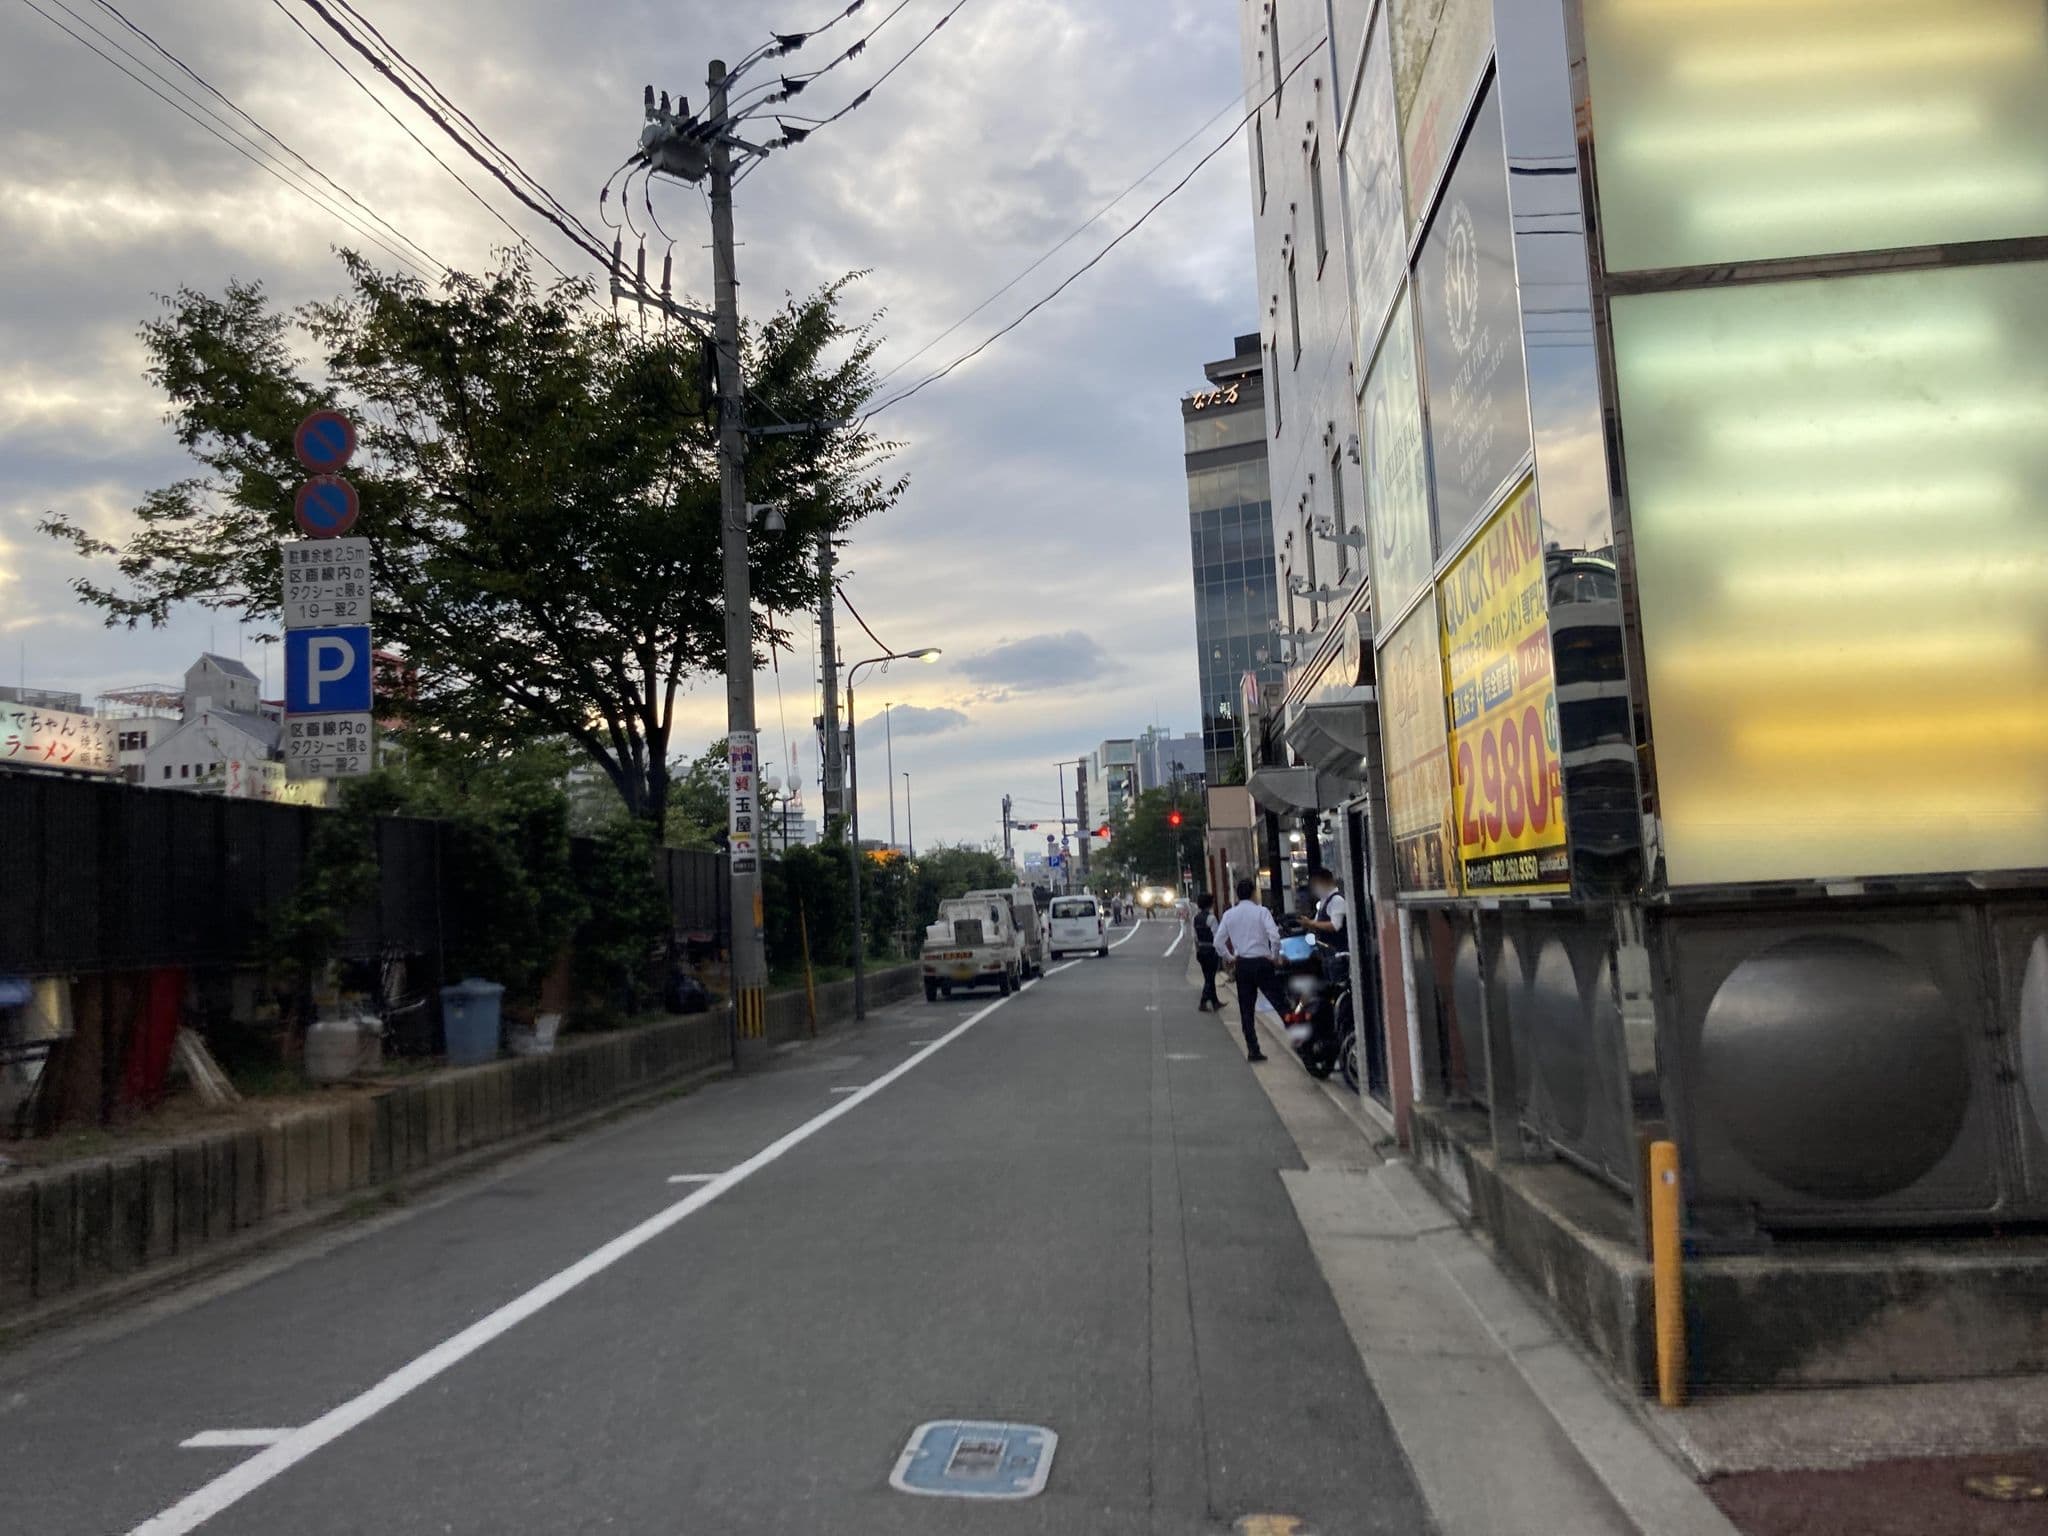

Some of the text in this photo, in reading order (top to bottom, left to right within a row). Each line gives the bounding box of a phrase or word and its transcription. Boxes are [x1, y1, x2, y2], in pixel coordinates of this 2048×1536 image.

[1193, 383, 1239, 409] なだ万
[289, 565, 365, 584] 区画線内の
[1442, 492, 1541, 637] QUICK HAND
[289, 582, 365, 600] タクシーに限る
[1524, 637, 1546, 677] ハンド
[307, 636, 356, 705] P
[290, 720, 367, 737] 区画線内の
[5, 735, 75, 763] ラーメン
[290, 737, 367, 755] タクシーに限る
